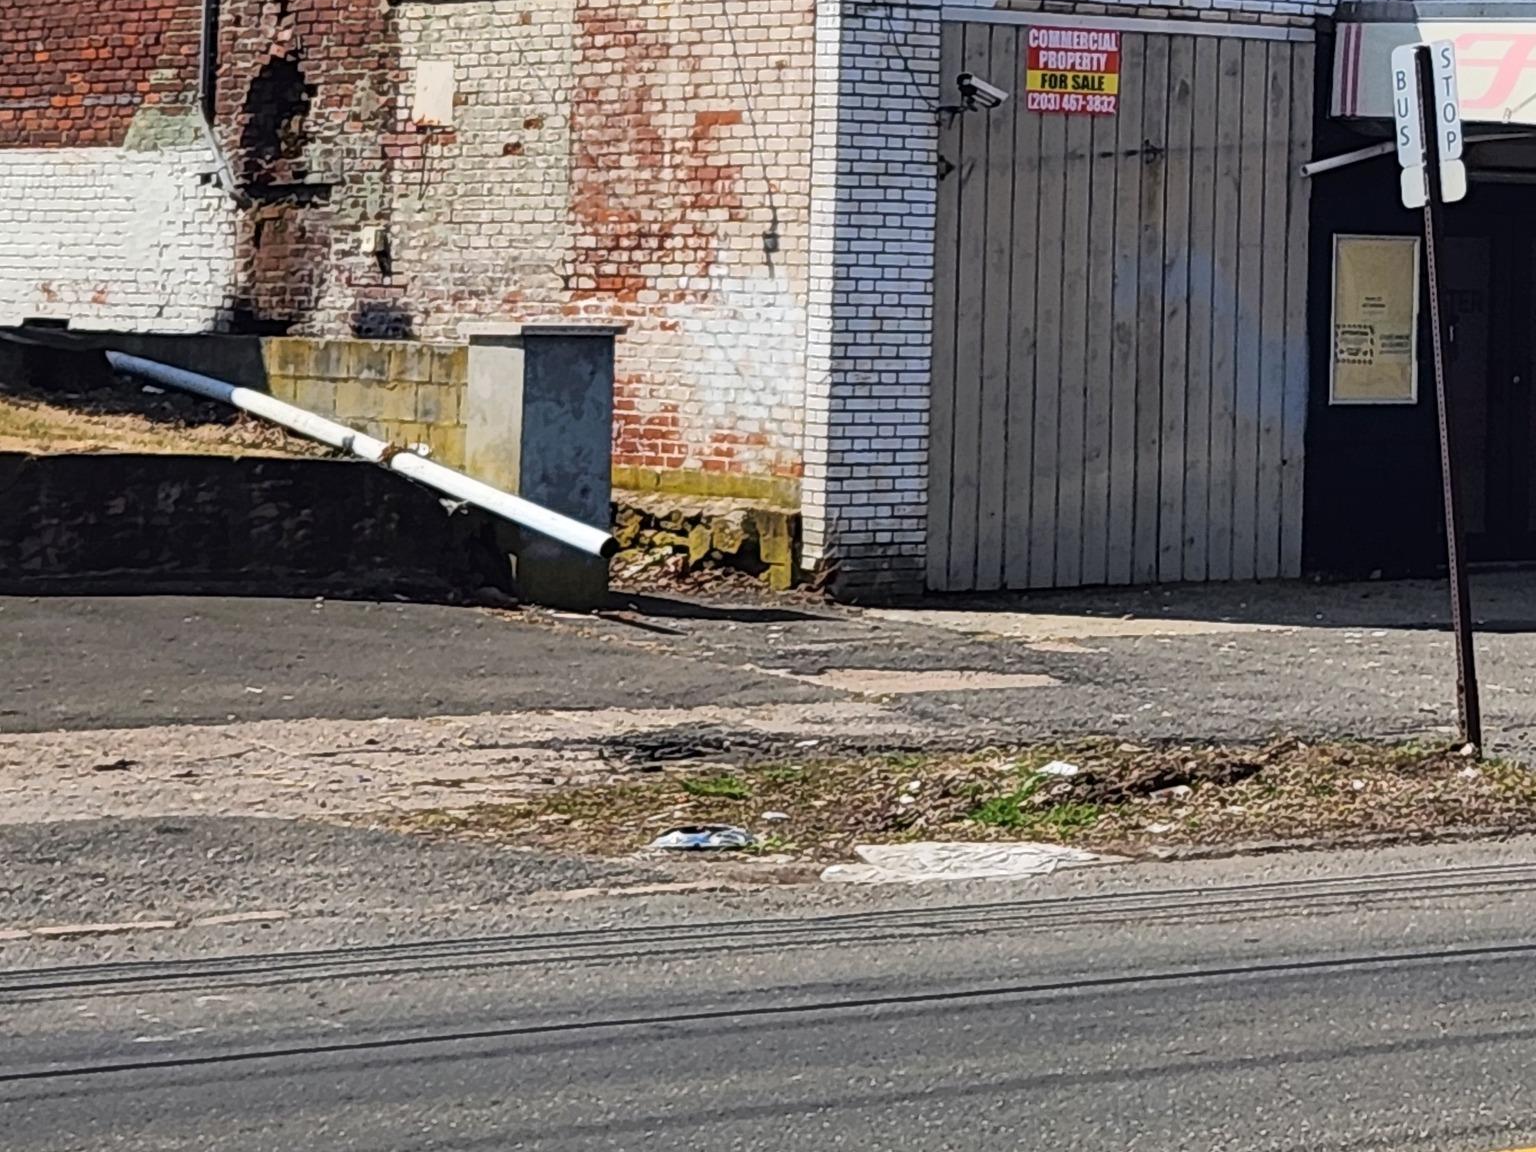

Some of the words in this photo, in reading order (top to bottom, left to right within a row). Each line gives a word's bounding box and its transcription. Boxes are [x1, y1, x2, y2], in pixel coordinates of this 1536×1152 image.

[1028, 28, 1119, 52] COMMERCIAL
[1038, 50, 1108, 72] PROPERTY
[1040, 72, 1069, 90] FOR
[1071, 74, 1105, 92] SALE
[1027, 92, 1060, 110] (203)
[1395, 70, 1410, 147] BUS
[1440, 47, 1457, 153] STOP
